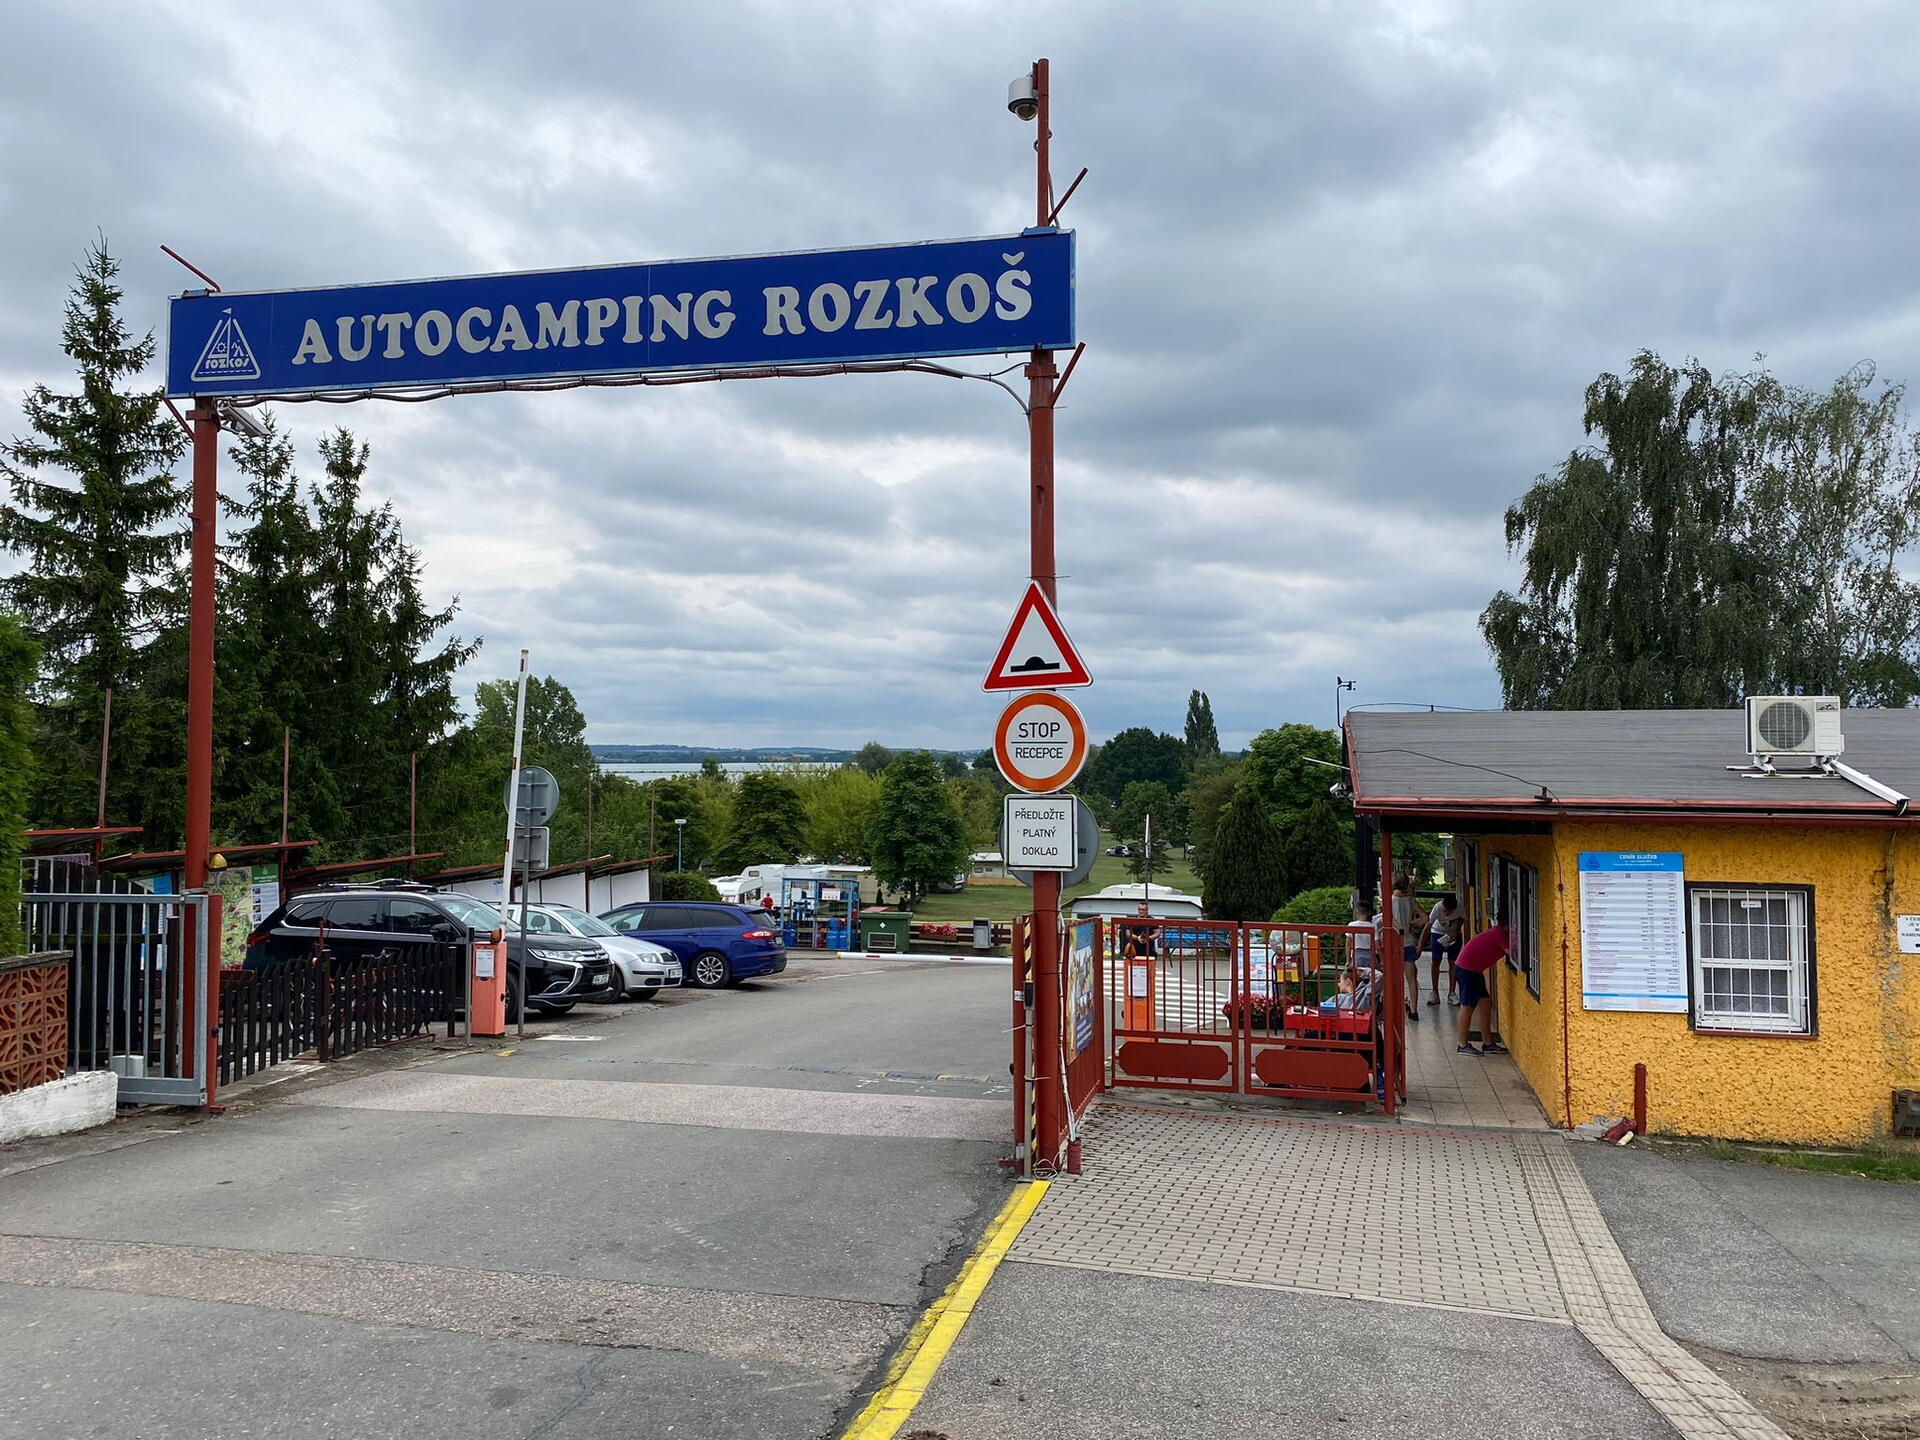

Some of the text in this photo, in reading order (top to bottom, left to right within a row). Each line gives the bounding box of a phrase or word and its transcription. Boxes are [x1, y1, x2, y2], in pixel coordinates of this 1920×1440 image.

[291, 251, 1032, 365] AUTOCAMPING ROZKOŠ
[1018, 722, 1061, 738] STOP
[1015, 747, 1064, 759] RECEPCE
[1015, 807, 1065, 820] PŘEDLOŽTE
[1022, 826, 1057, 838] PLATNÝ
[1022, 846, 1058, 856] DOKLAD
